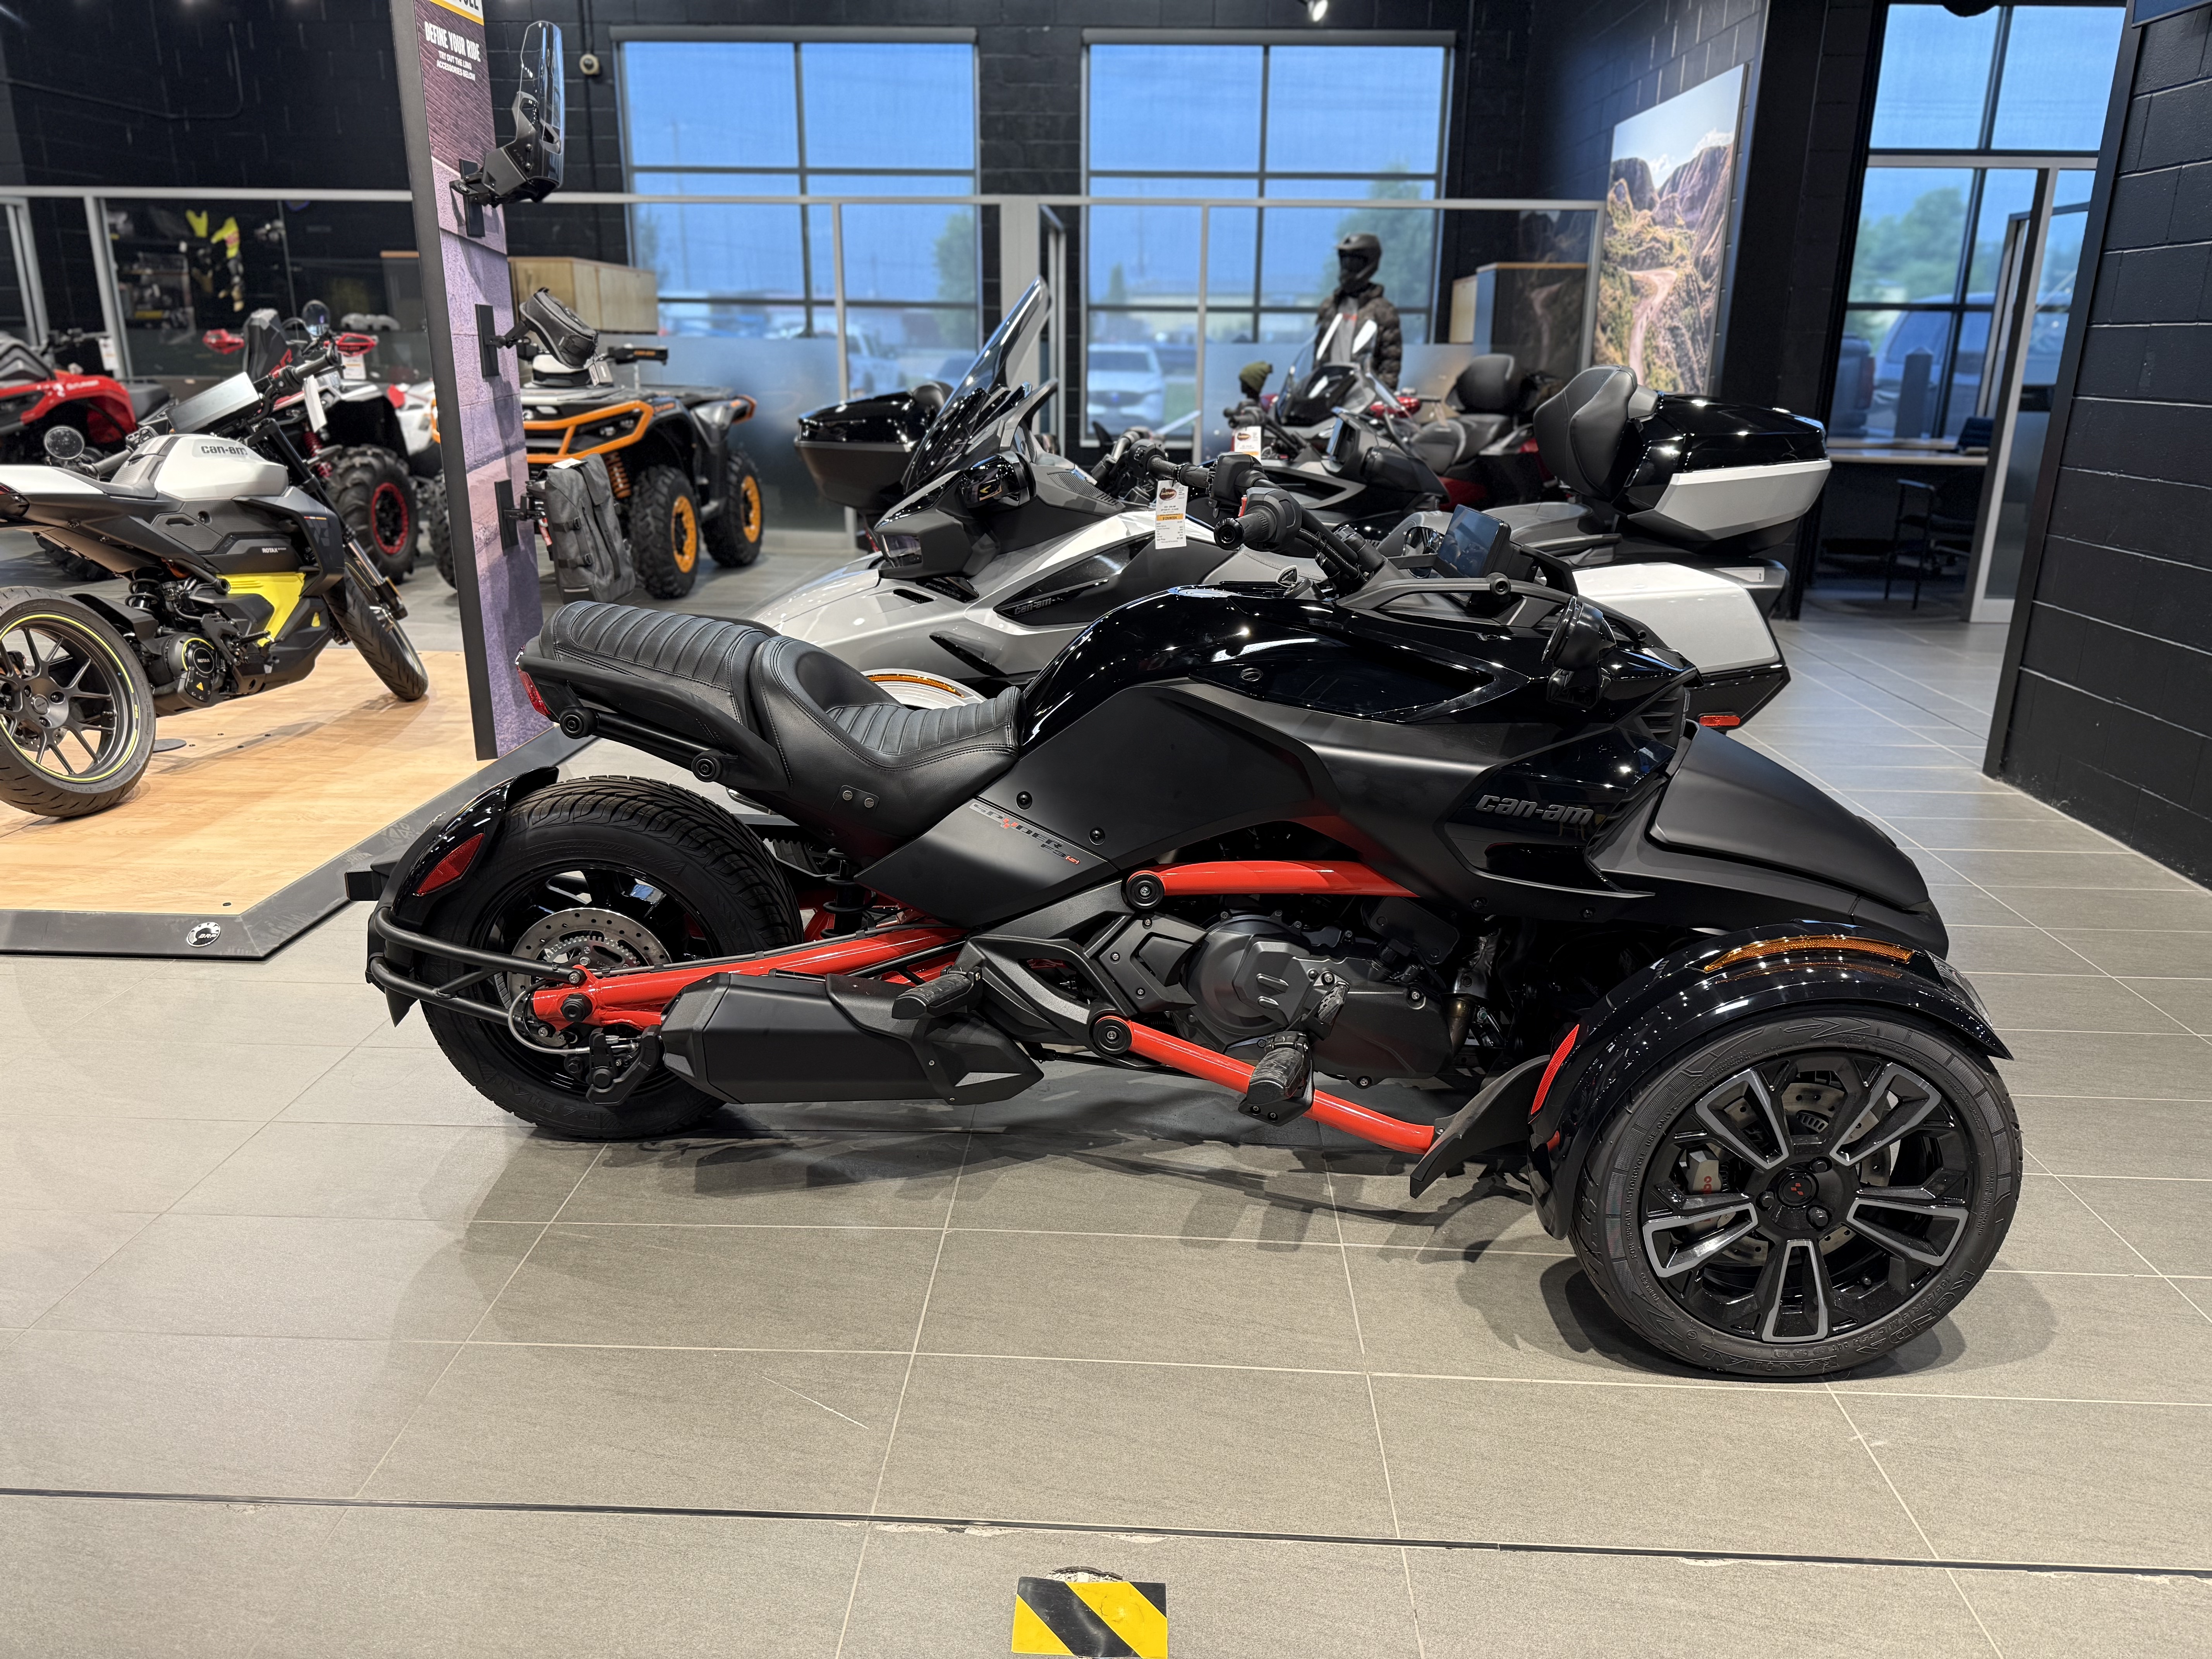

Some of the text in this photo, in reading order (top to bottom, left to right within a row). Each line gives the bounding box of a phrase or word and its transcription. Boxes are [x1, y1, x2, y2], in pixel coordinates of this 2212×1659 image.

[424, 21, 481, 62] DEFINE YOUR RIDE
[436, 60, 476, 81] ACCESSORIES BELOW
[438, 50, 447, 59] TRY
[447, 53, 455, 64] OUT
[455, 57, 463, 67] THE
[201, 445, 248, 455] can-am
[1014, 598, 1051, 615] can-am
[1475, 795, 1594, 825] can-am
[973, 804, 1063, 849] SPYDER
[1626, 1149, 1647, 1204] MOTORCYCLE
[1645, 1131, 1658, 1146] USE
[1656, 1111, 1673, 1128] ONLY
[1638, 1272, 1661, 1301] TUBELESS
[1856, 1270, 1975, 1355] KENDA
